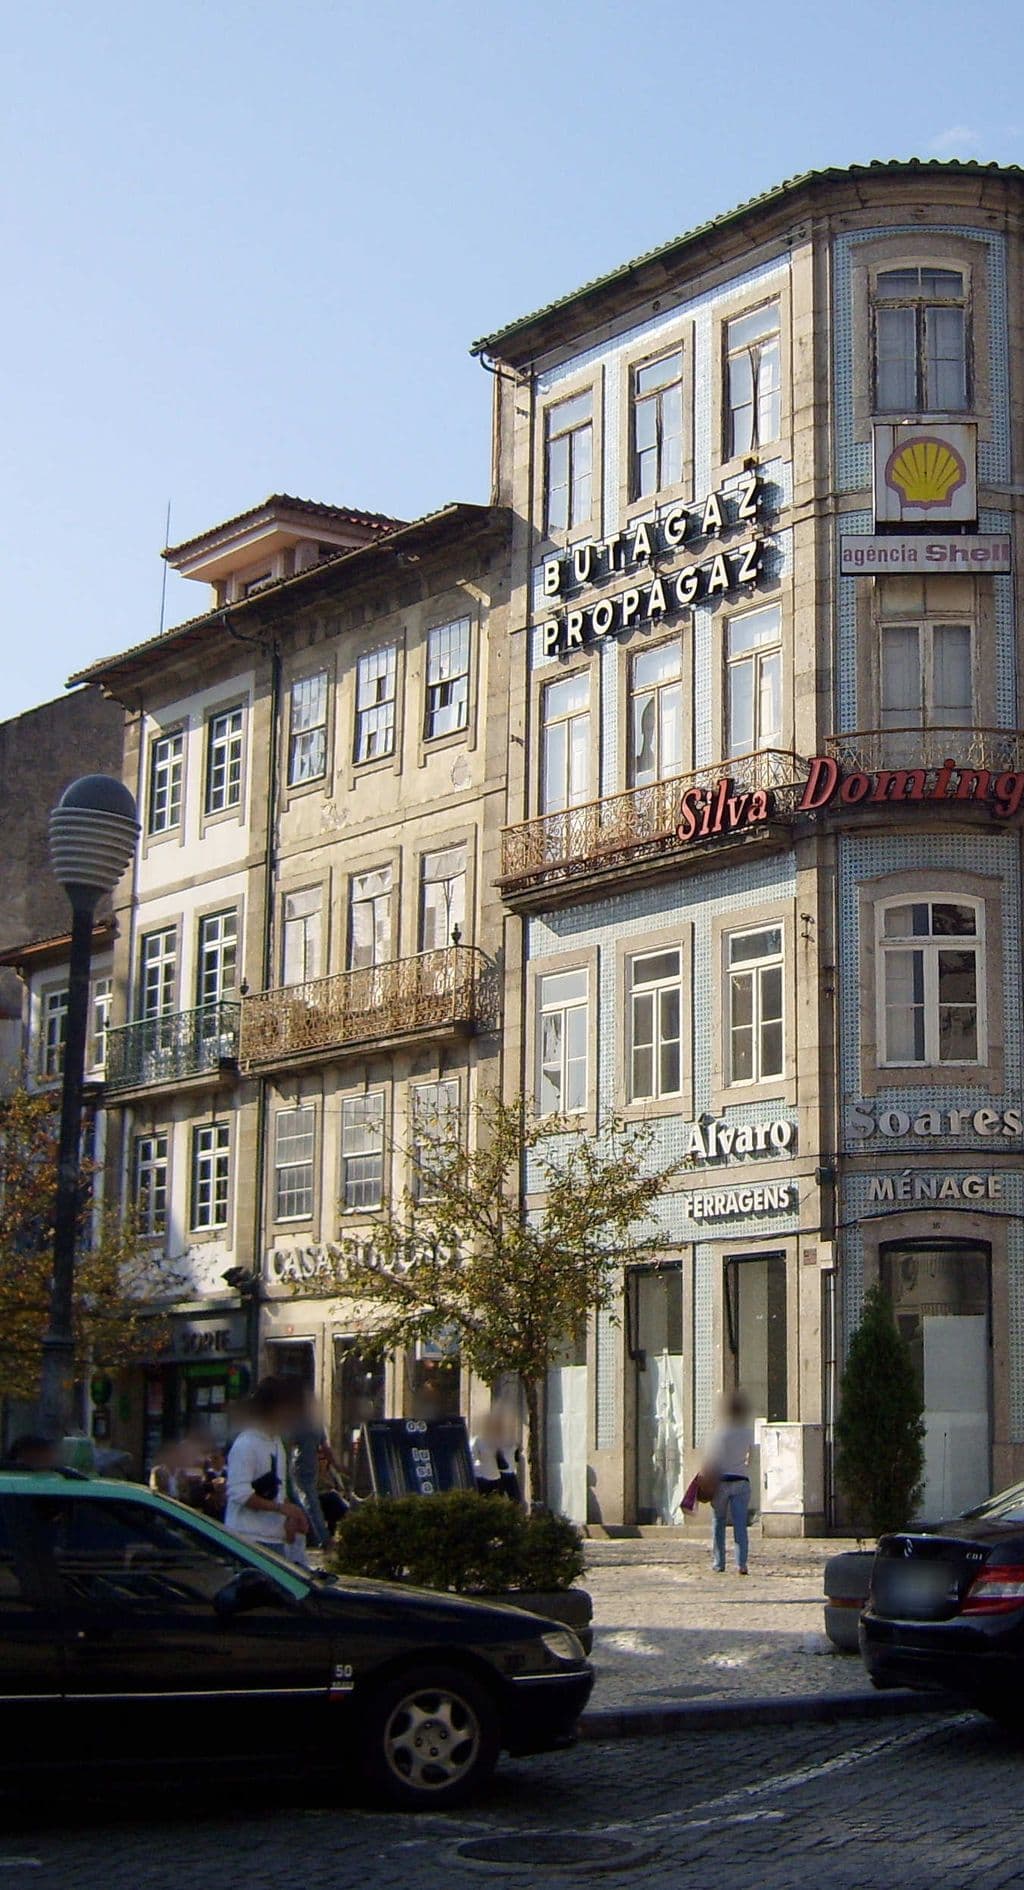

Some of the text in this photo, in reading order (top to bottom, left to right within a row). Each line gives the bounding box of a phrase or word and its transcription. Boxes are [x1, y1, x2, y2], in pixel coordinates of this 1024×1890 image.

[543, 477, 763, 597] BUTAGAZ
[842, 543, 1010, 566] agência Shell
[542, 542, 762, 656] PROPAGAZ
[677, 778, 769, 841] Silva
[849, 1103, 1024, 1139] Soares
[685, 1186, 790, 1218] FERRAGENS
[868, 1171, 1001, 1201] MÉNAGE
[268, 1247, 335, 1282] CASA
